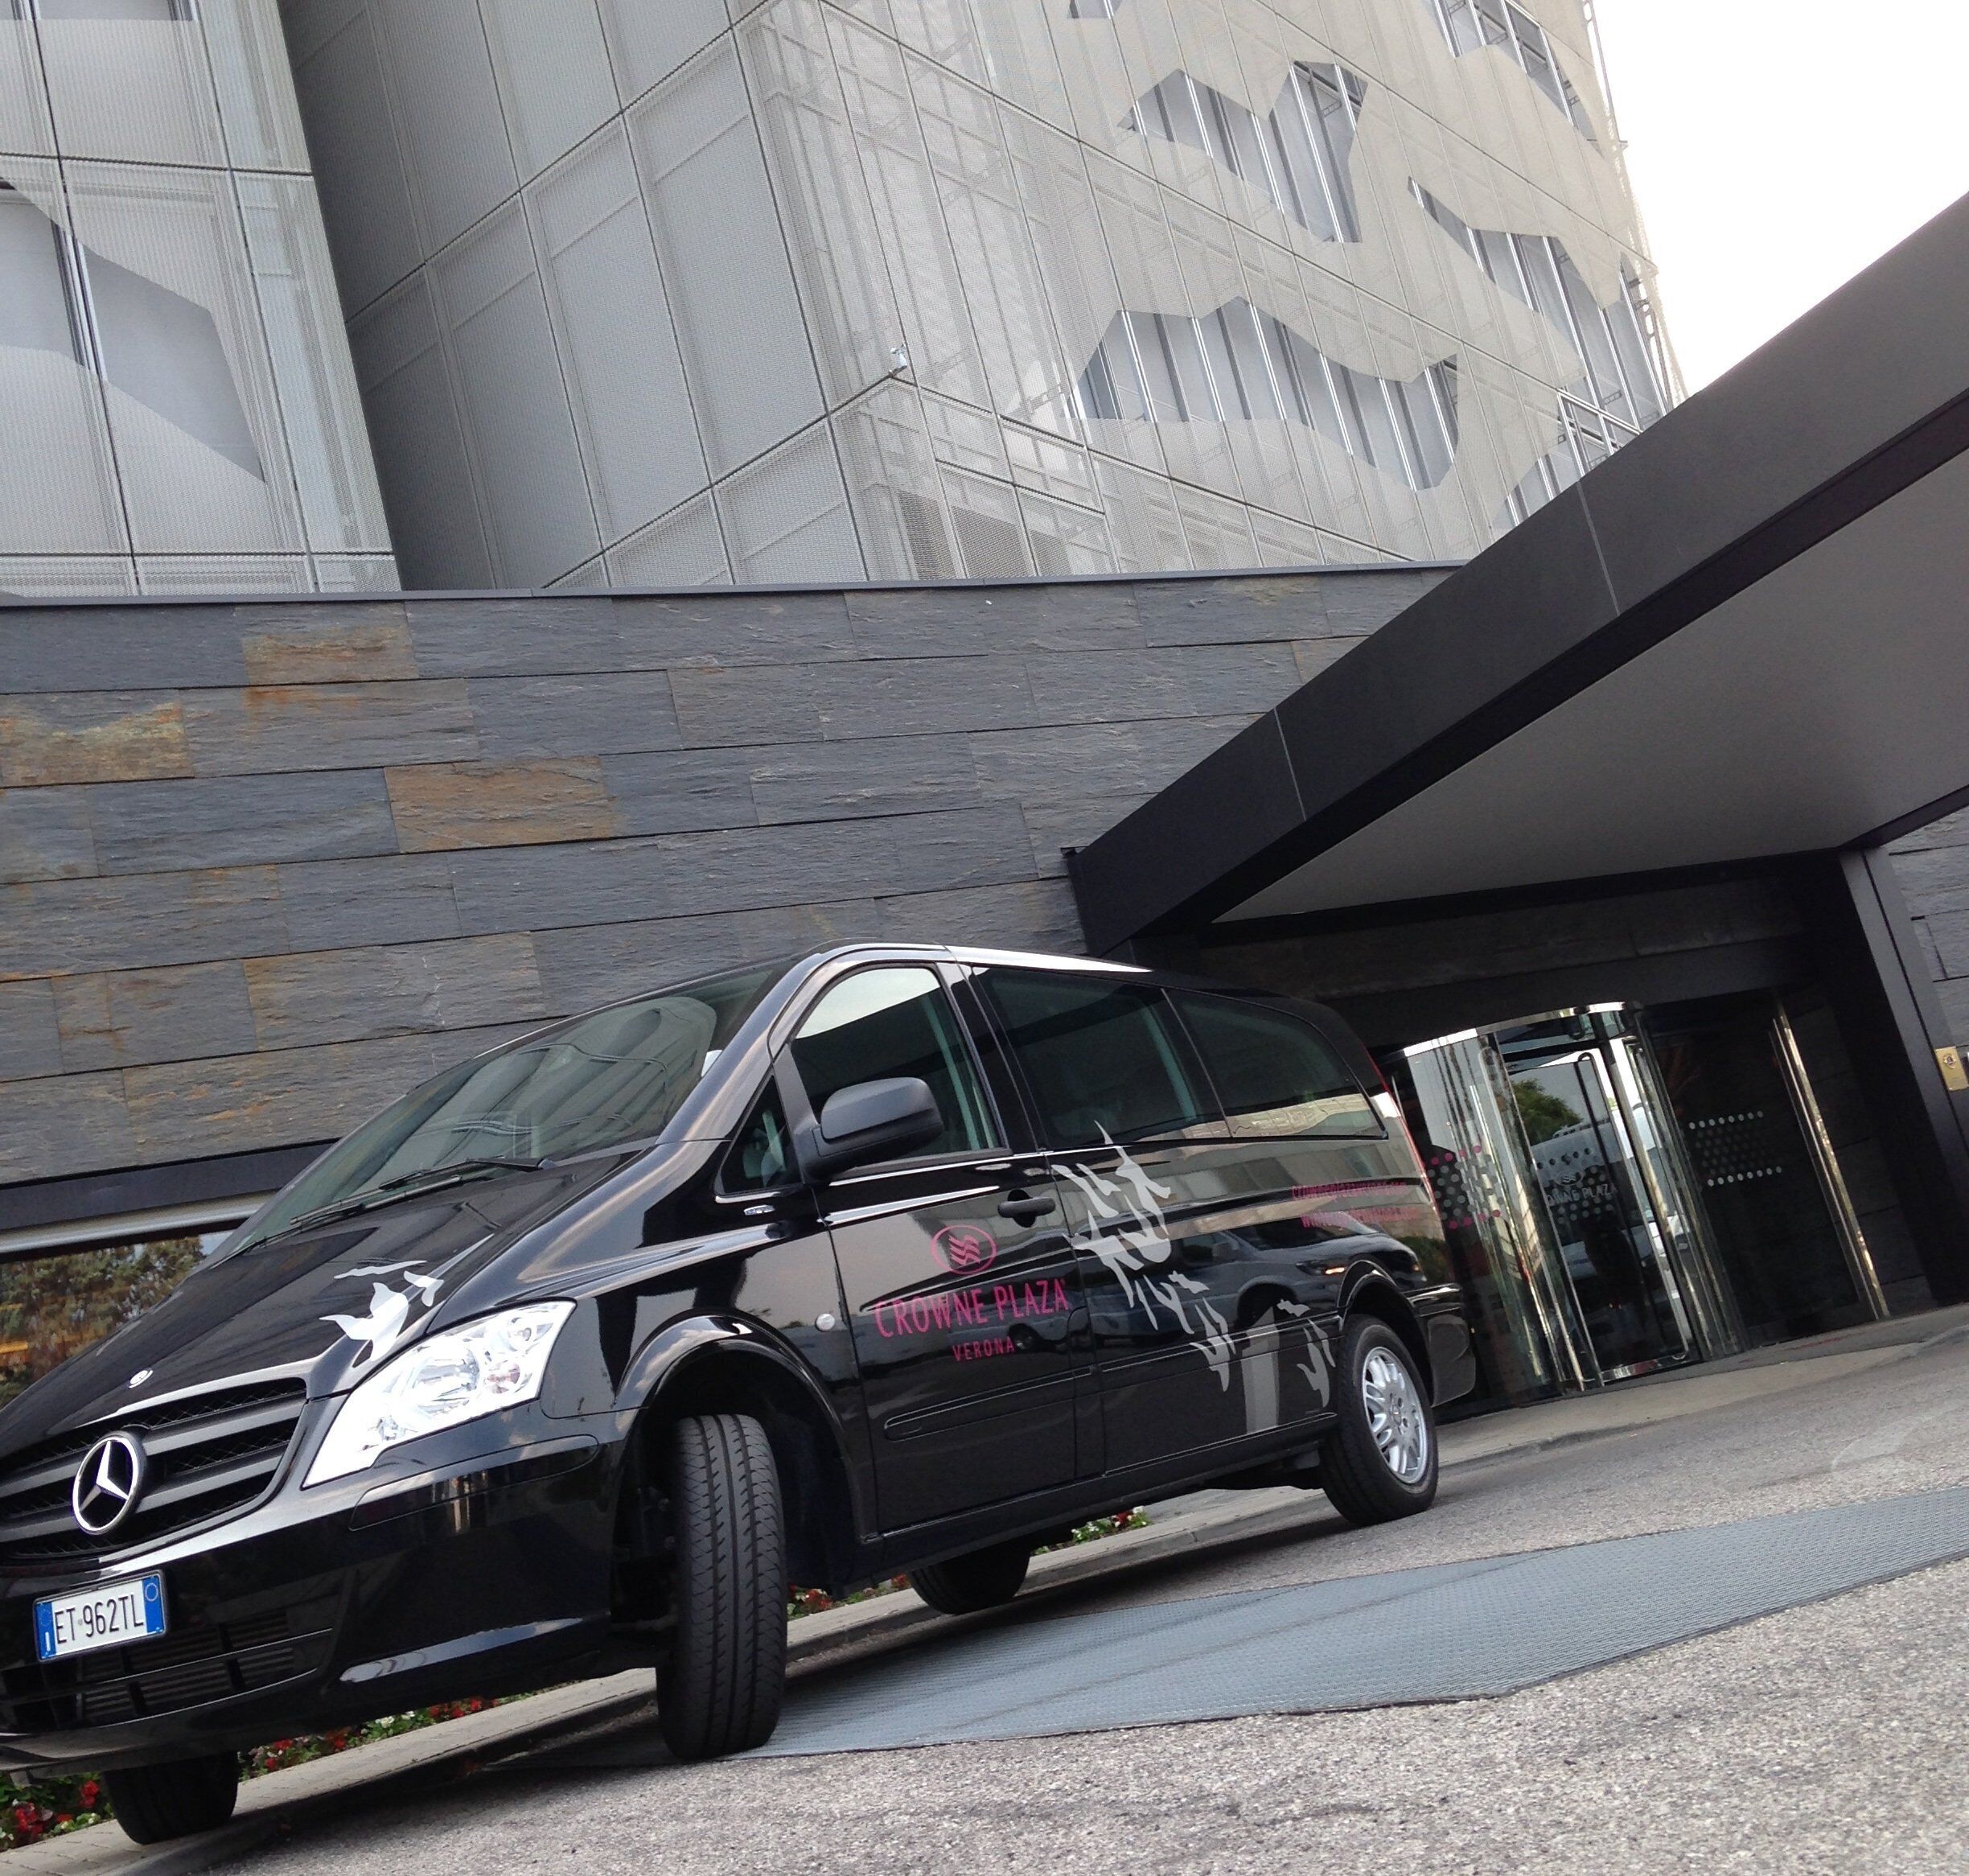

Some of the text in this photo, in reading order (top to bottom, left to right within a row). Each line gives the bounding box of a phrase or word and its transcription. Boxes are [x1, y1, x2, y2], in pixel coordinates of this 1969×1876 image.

[874, 1277, 1069, 1338] CROWNE PLAZA
[952, 1336, 1014, 1361] VERONA
